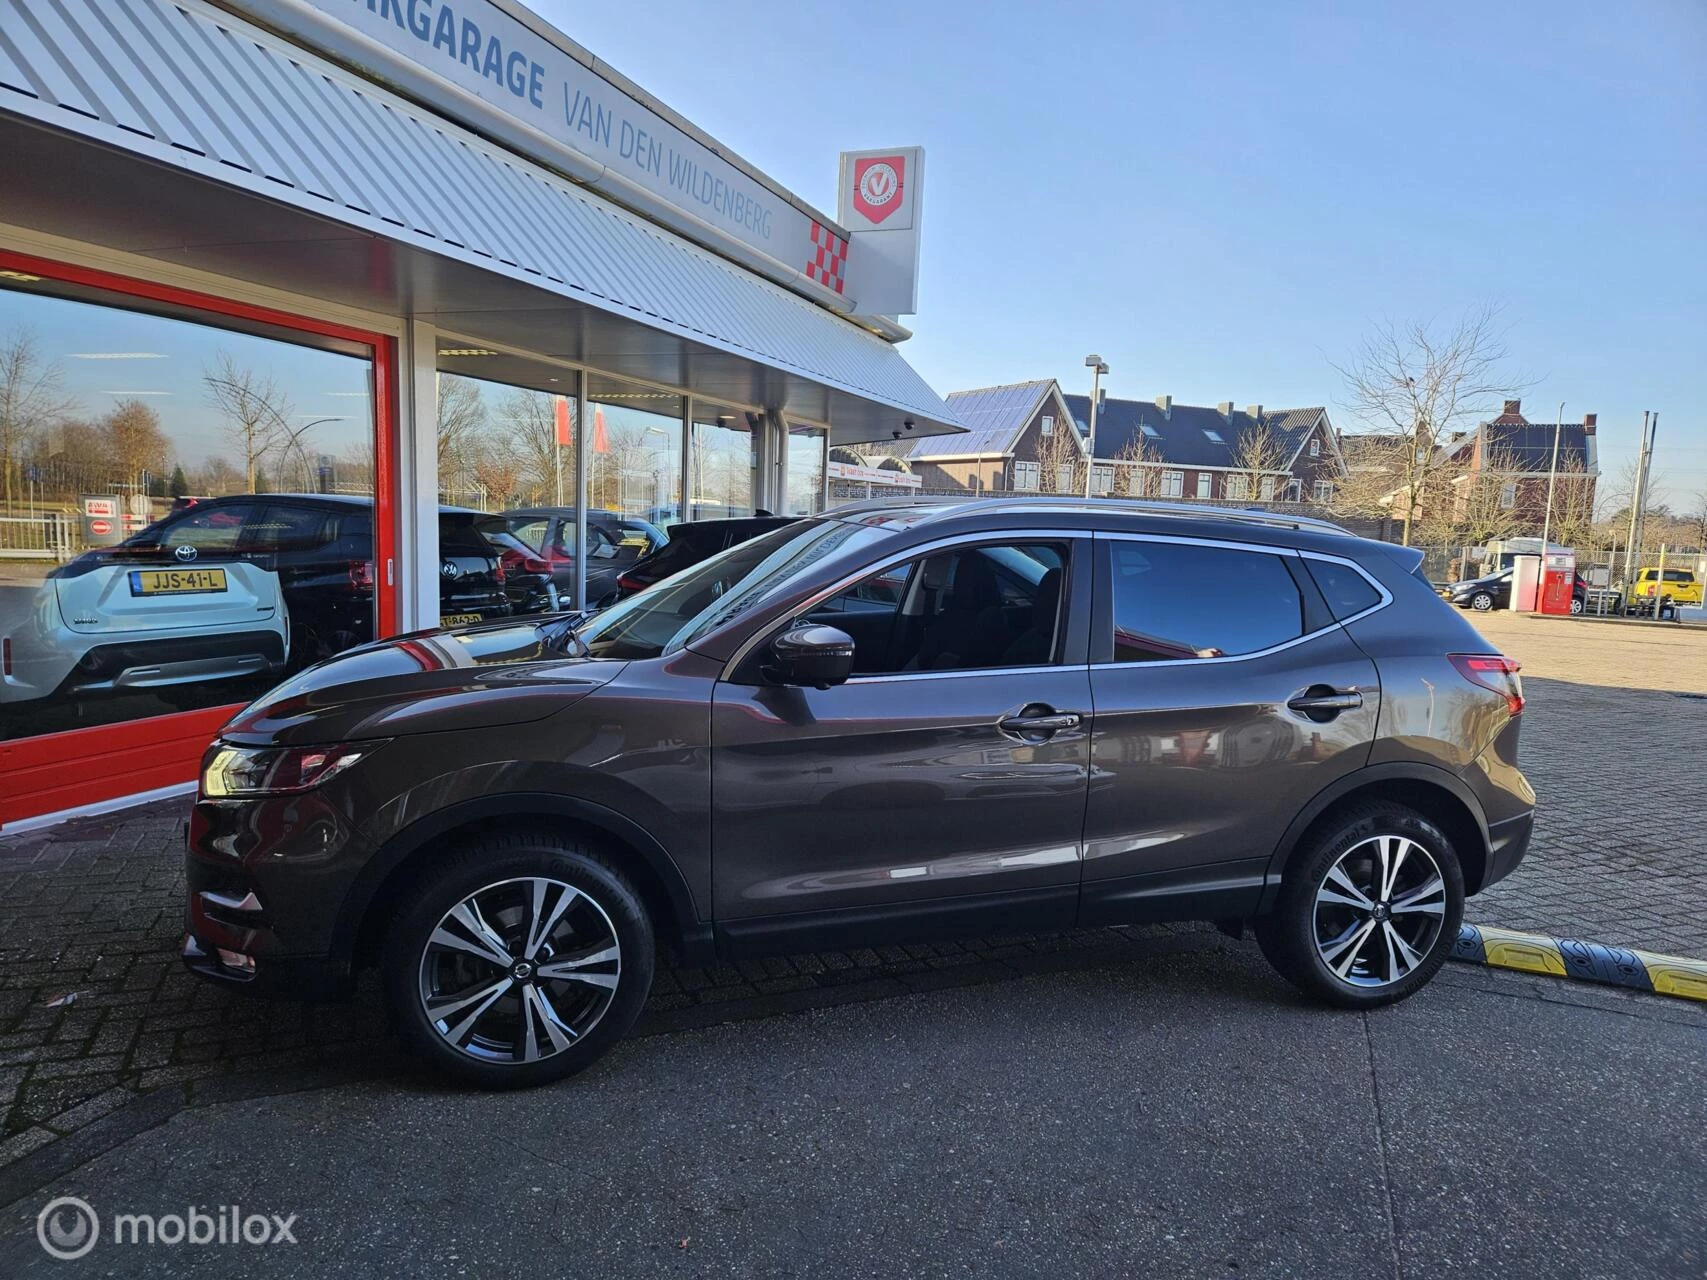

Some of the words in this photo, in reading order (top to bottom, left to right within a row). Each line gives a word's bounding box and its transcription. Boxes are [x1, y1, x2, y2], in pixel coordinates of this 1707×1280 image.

[352, 0, 545, 110] GARAGE
[563, 81, 613, 148] VAN
[619, 119, 662, 177] DEN
[669, 148, 774, 241] WILDENBERG
[153, 571, 218, 589] JJS-41-L
